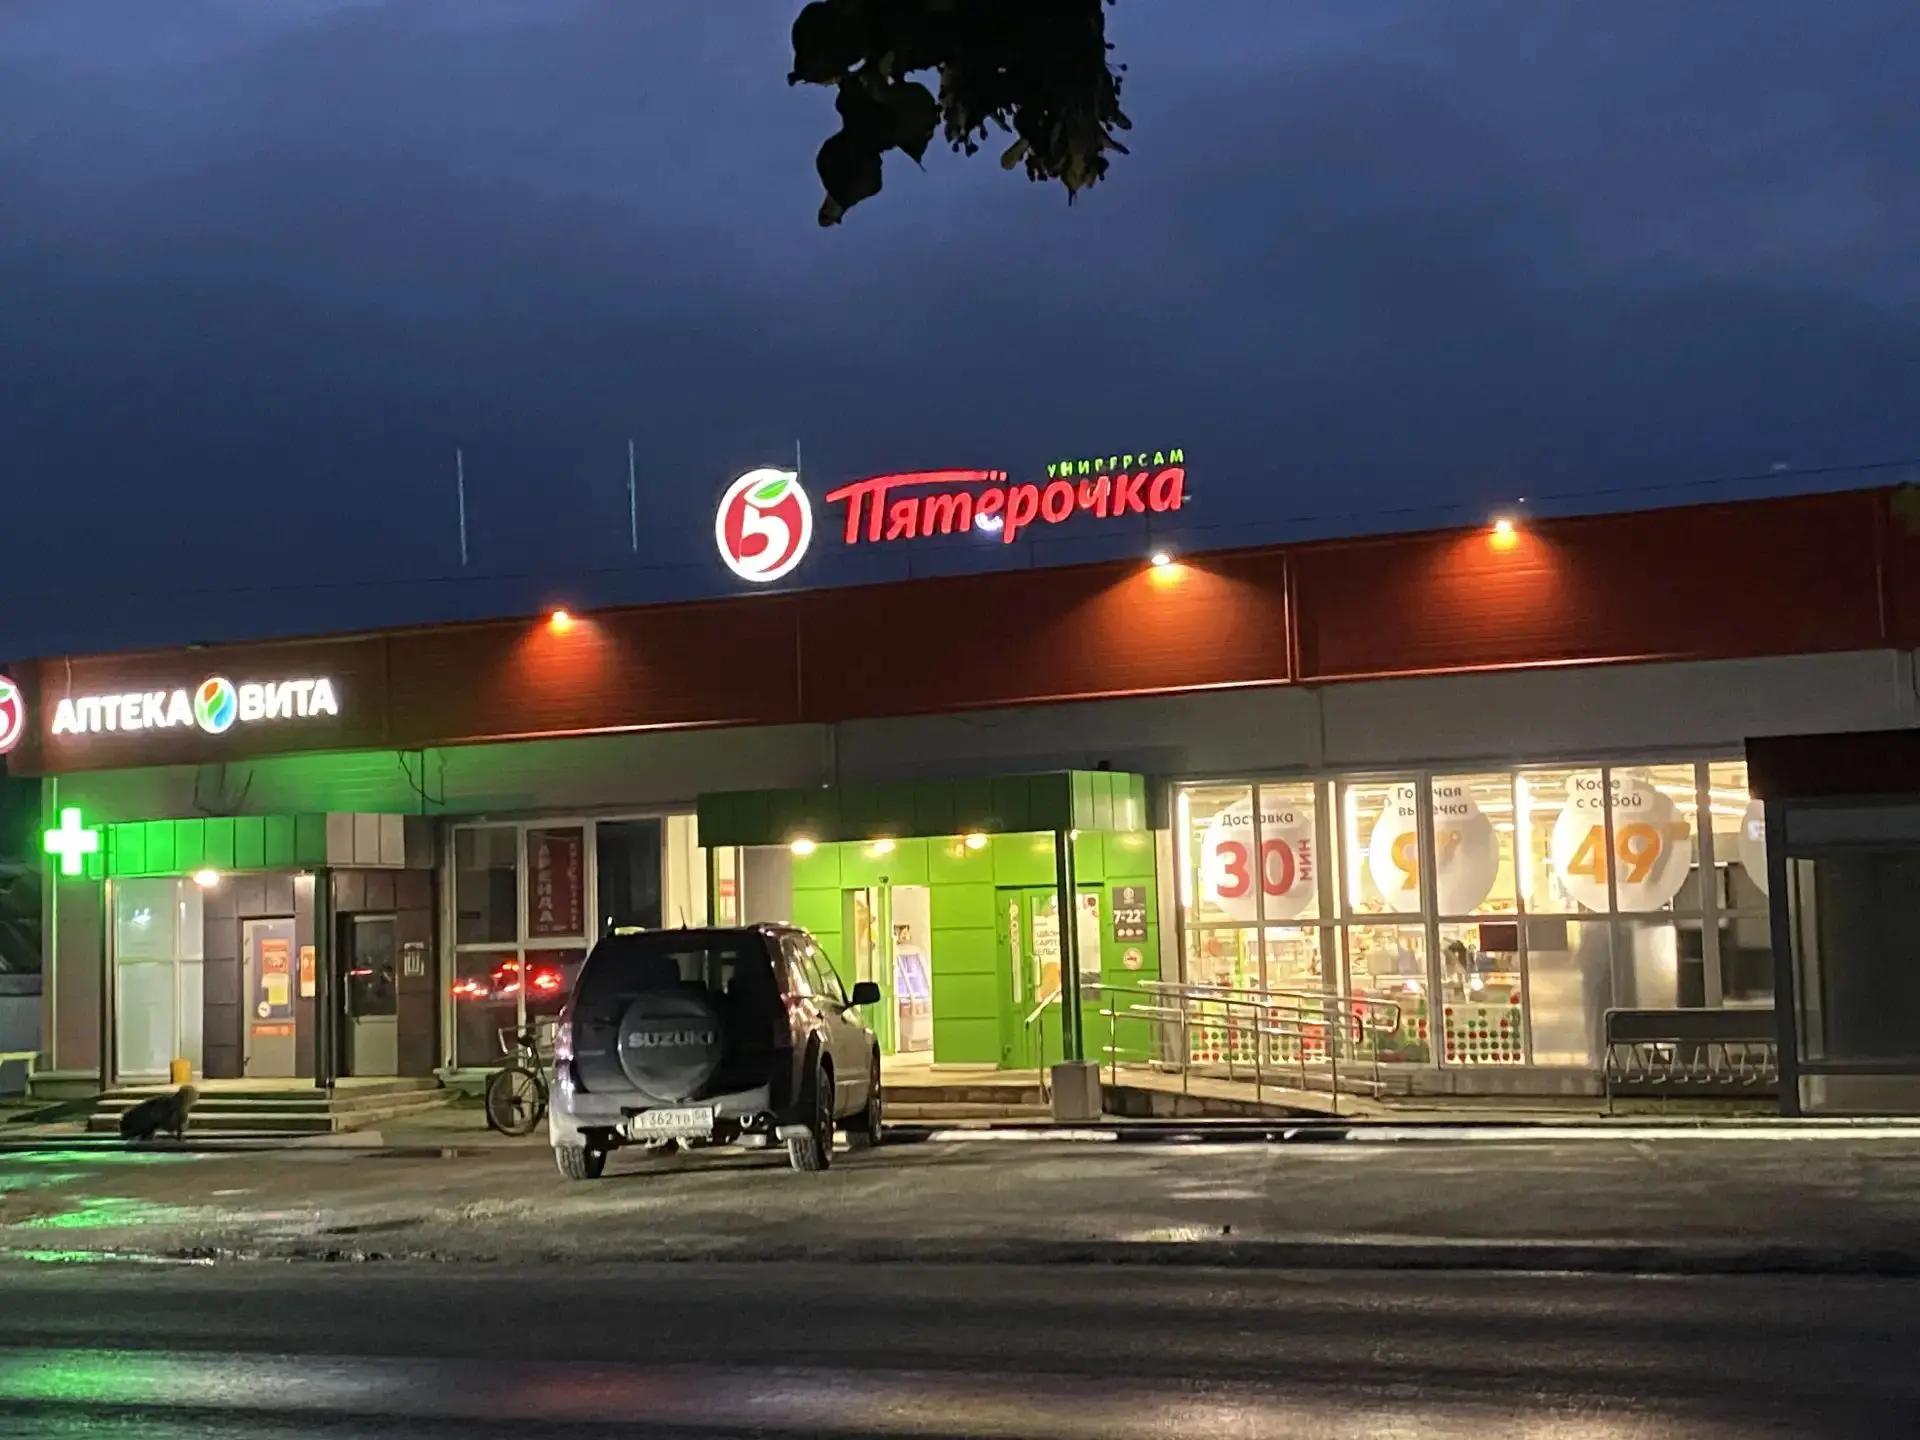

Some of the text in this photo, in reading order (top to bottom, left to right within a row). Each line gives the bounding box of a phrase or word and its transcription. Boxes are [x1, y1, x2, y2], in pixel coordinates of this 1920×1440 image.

[52, 690, 194, 735] АПТЕКА
[238, 678, 339, 721] ВИТА
[1397, 787, 1462, 800] Гочая
[1398, 803, 1468, 816] выечка
[1222, 812, 1294, 827] Досавка
[1215, 838, 1295, 898] 30
[628, 1031, 713, 1048] SUZUKI
